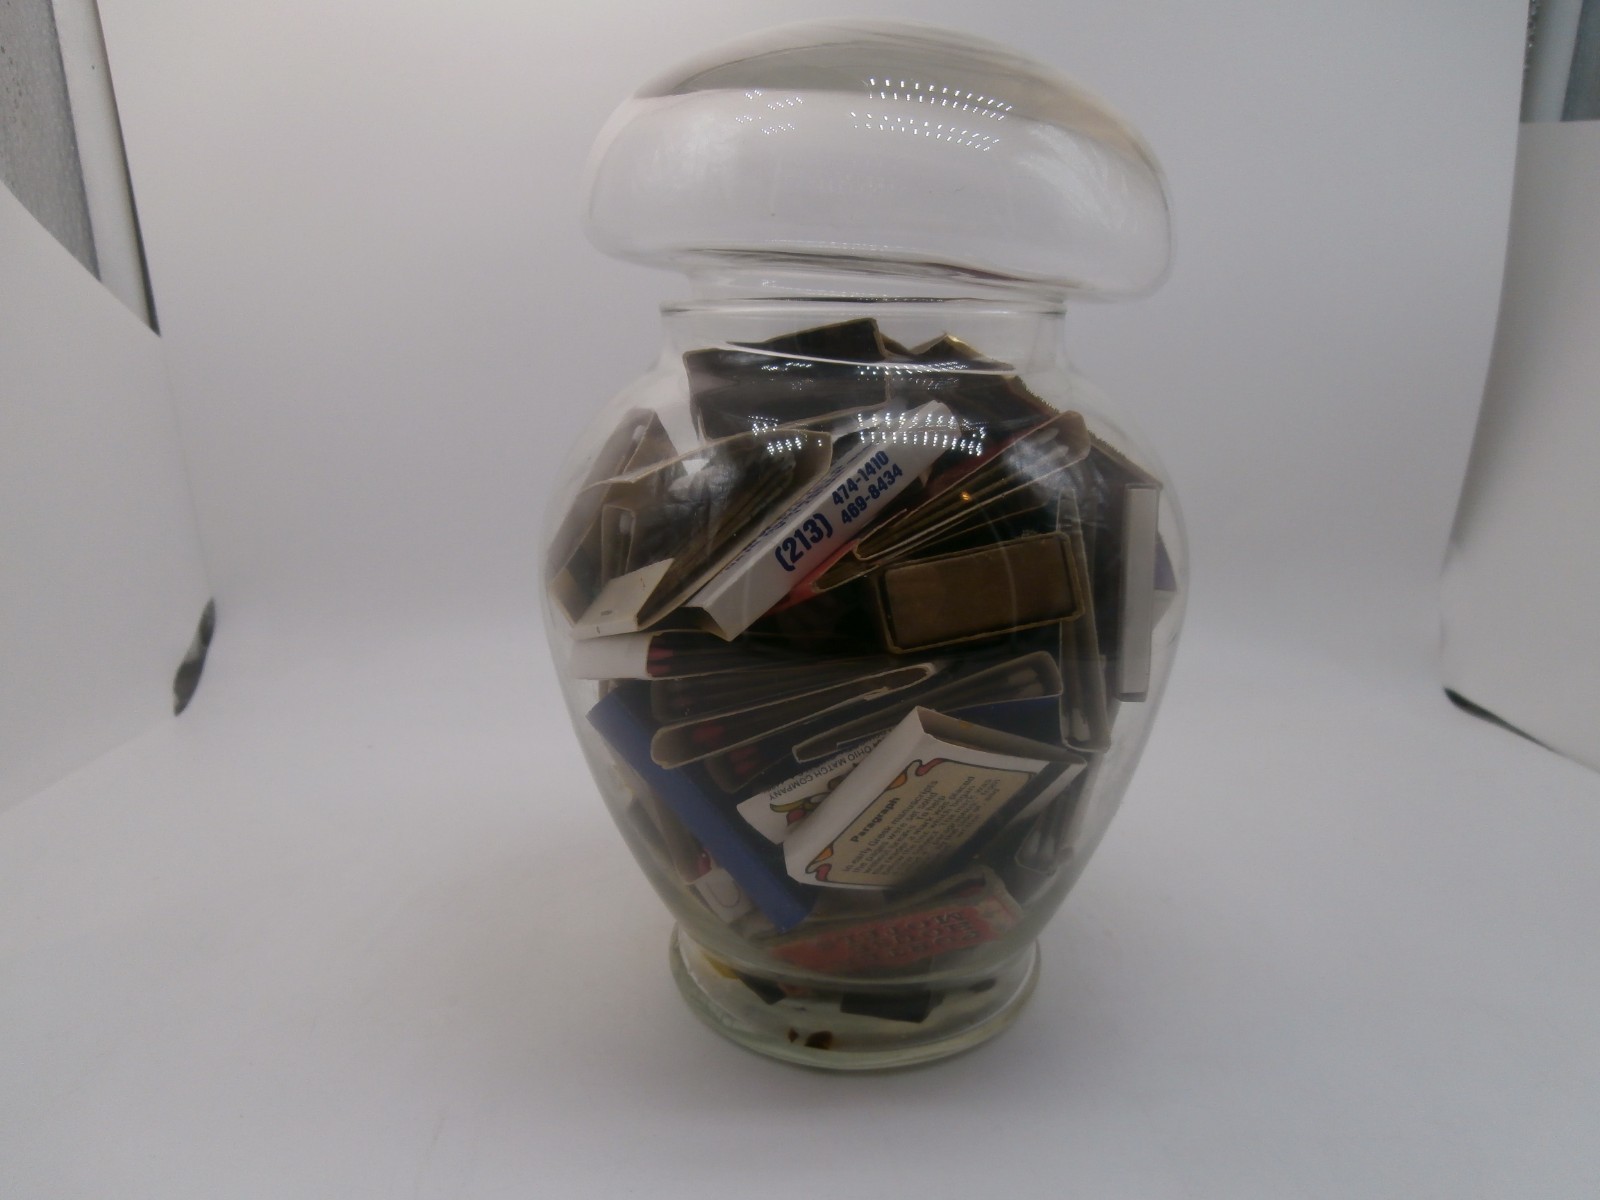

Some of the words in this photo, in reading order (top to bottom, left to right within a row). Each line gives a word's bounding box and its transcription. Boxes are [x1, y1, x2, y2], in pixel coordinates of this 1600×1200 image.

[832, 451, 889, 505] 474-1410
[841, 463, 903, 524] 469-8434
[775, 513, 833, 571] (213)
[814, 758, 847, 778] MATCH
[847, 745, 872, 761] OHIO
[769, 774, 814, 800] COMPANY
[923, 795, 947, 810] help
[945, 776, 977, 799] placed
[947, 786, 978, 807] began
[850, 797, 900, 842] Paragraph
[864, 826, 894, 846] Greek
[888, 780, 940, 824] manuscripts
[885, 823, 908, 839] were
[913, 792, 939, 808] solid
